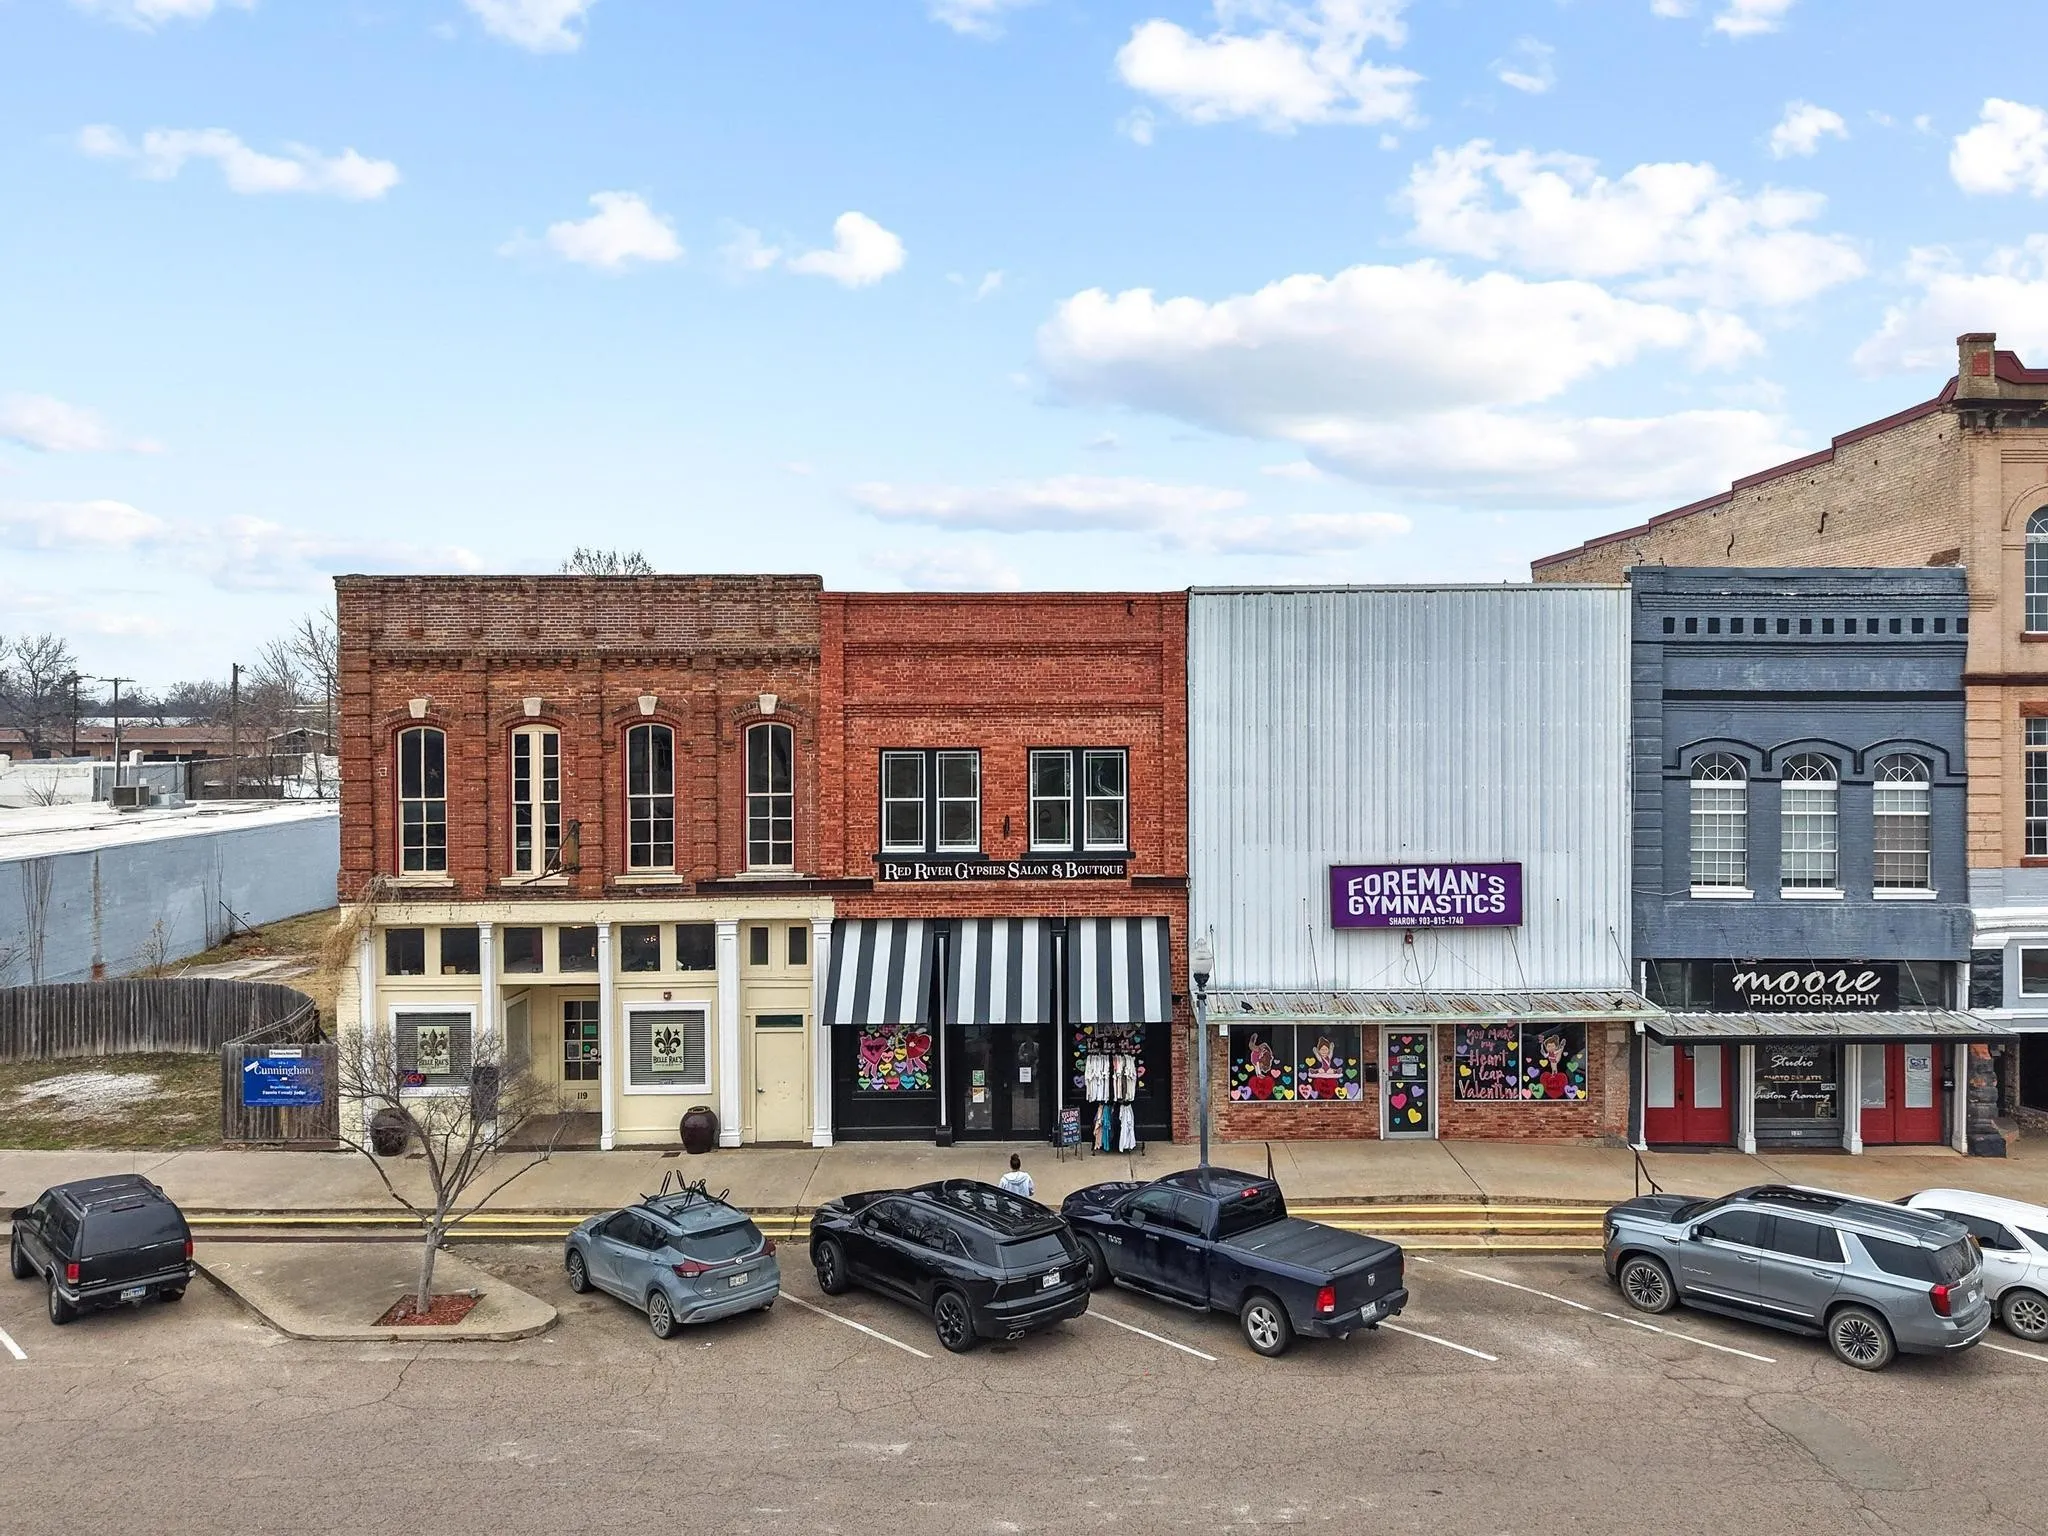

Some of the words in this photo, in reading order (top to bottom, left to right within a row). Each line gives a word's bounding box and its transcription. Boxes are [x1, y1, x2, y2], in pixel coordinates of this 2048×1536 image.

[884, 863, 912, 880] RED
[914, 863, 953, 880] RIVER
[955, 862, 1006, 879] GYPSIES
[1007, 861, 1049, 879] SALON
[1051, 863, 1063, 878] &
[1065, 862, 1124, 878] BOUTIQUE
[1348, 868, 1506, 896] FOREMAN'S
[1348, 894, 1506, 915] GYMNASTICS
[1389, 917, 1418, 926] SHARON:
[1732, 969, 1882, 993] moore
[1750, 994, 1880, 1006] PHOTOGRAPHY
[1468, 1049, 1508, 1067] Heart
[1771, 1055, 1814, 1068] Studio
[254, 1065, 314, 1077] Cunningham
[577, 1092, 588, 1100] 119
[1755, 1088, 1786, 1099] Custom
[1790, 1090, 1830, 1102] Framing
